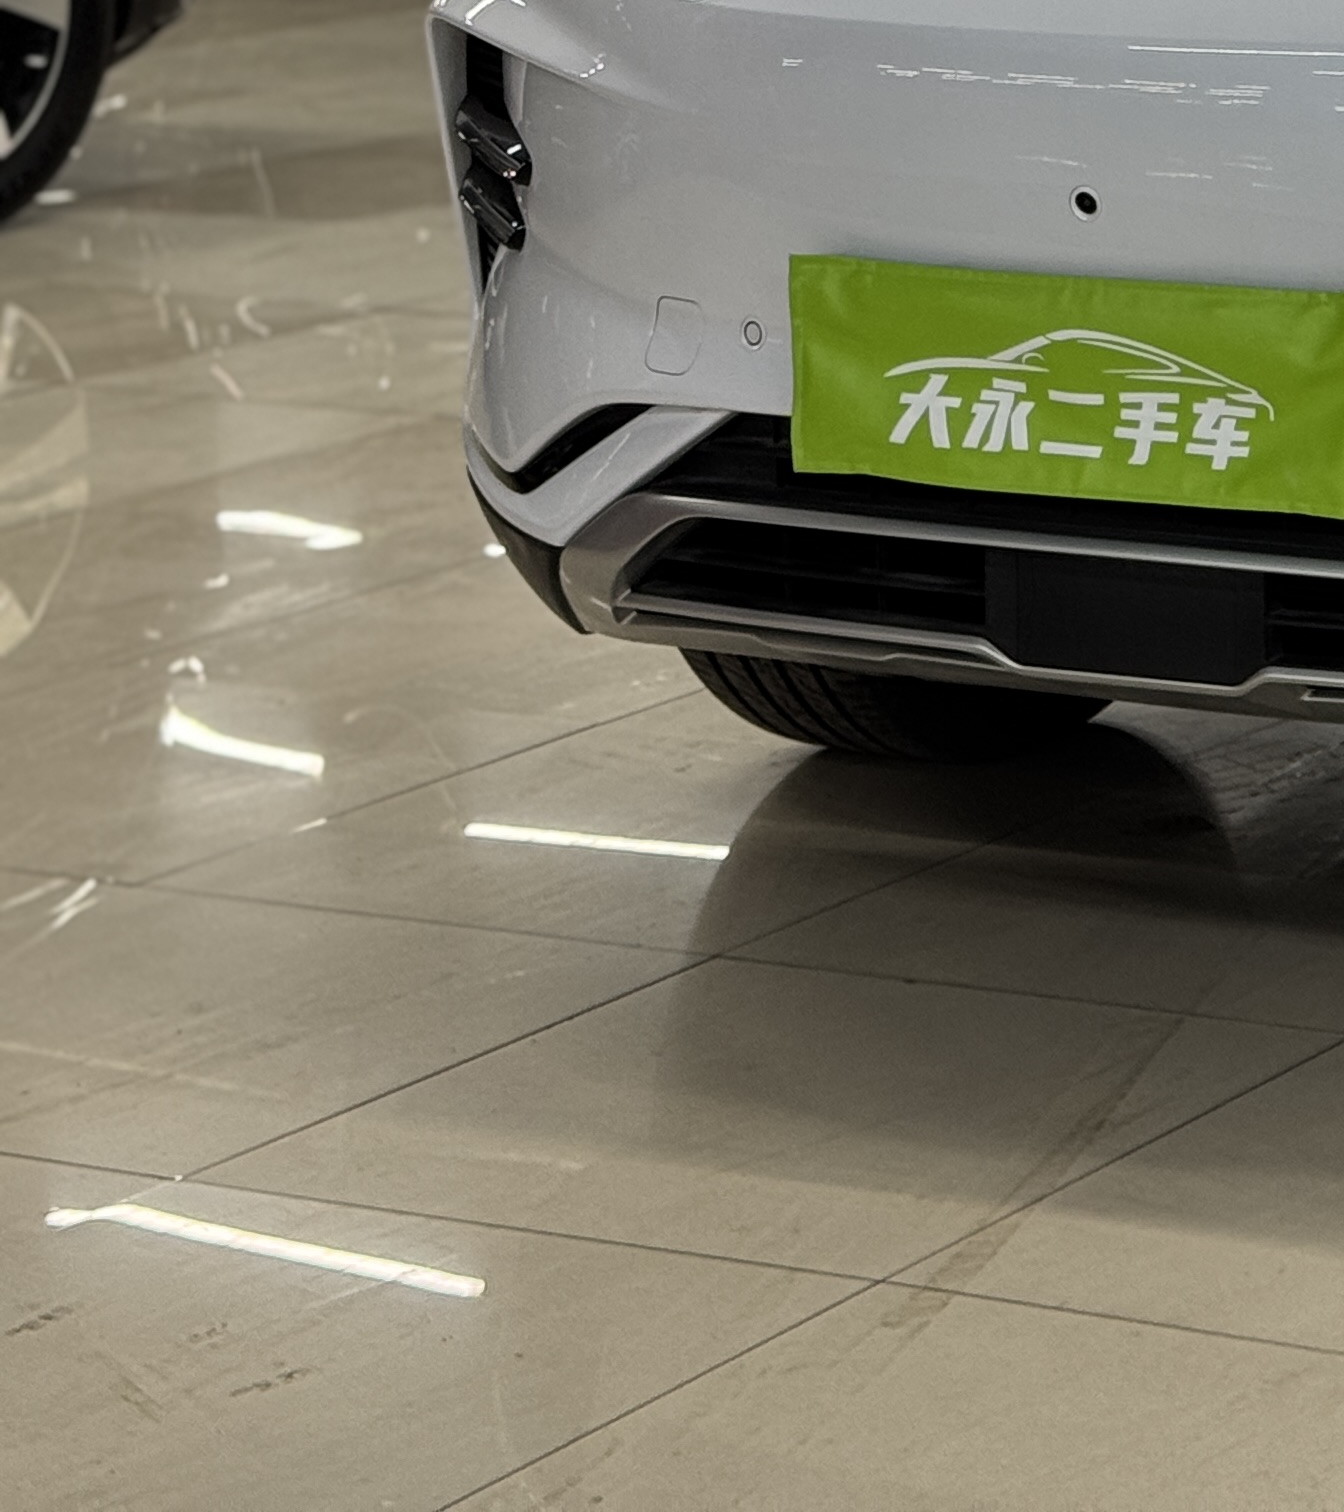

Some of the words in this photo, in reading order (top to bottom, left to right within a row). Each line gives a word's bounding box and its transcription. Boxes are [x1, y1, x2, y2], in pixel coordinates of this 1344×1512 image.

[889, 374, 1257, 471] 大永二手车
